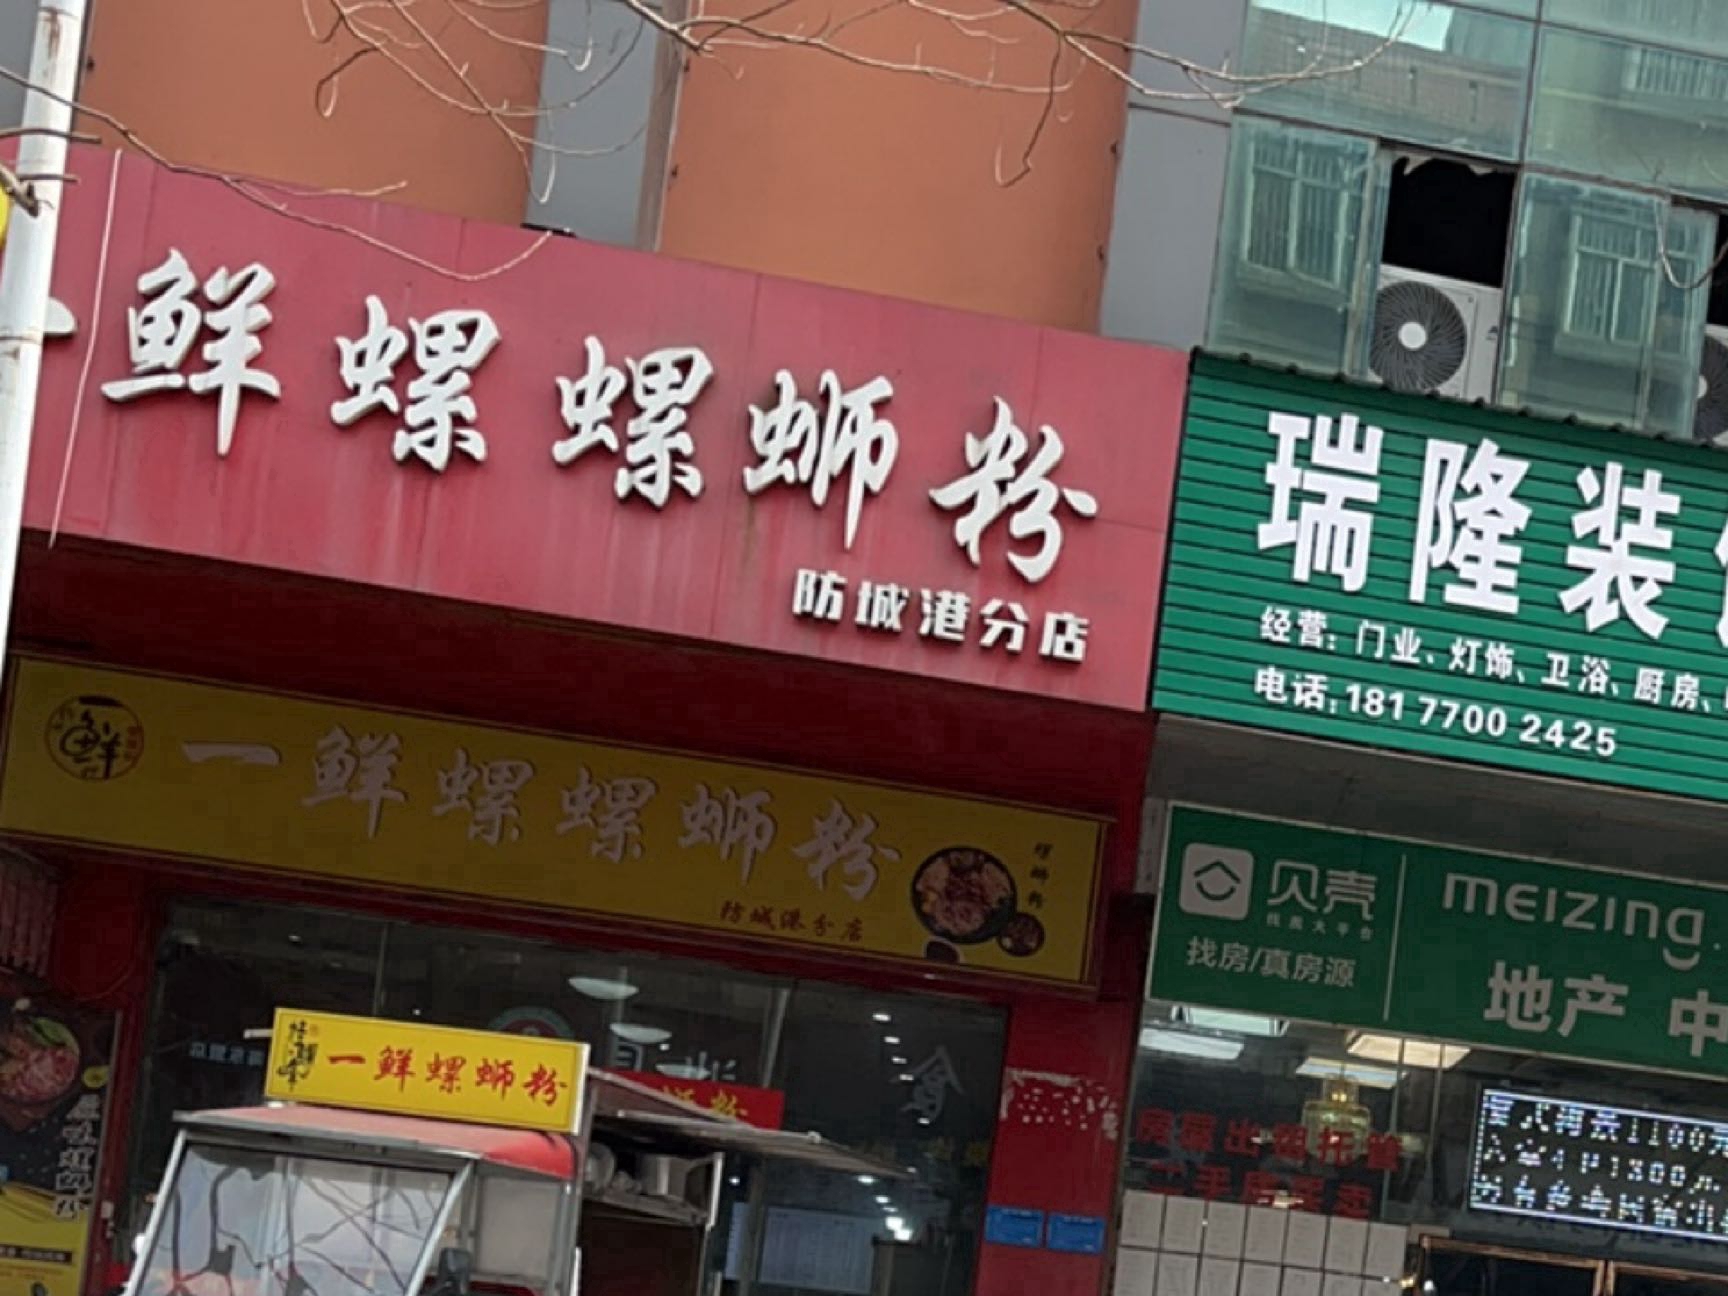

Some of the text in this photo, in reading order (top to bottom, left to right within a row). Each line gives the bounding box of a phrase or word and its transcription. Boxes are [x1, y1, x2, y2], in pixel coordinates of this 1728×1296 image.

[792, 569, 1091, 663] 防城港分店
[1419, 698, 1507, 737] 7700
[1519, 713, 1617, 757] 2425
[182, 724, 902, 901] 一鲜螺螺蛳粉
[1266, 858, 1378, 922] 贝壳
[1185, 935, 1358, 988] 找房/真房源
[1483, 958, 1630, 1038] 地产
[328, 1045, 568, 1107] 一鲜螺蛳粉
